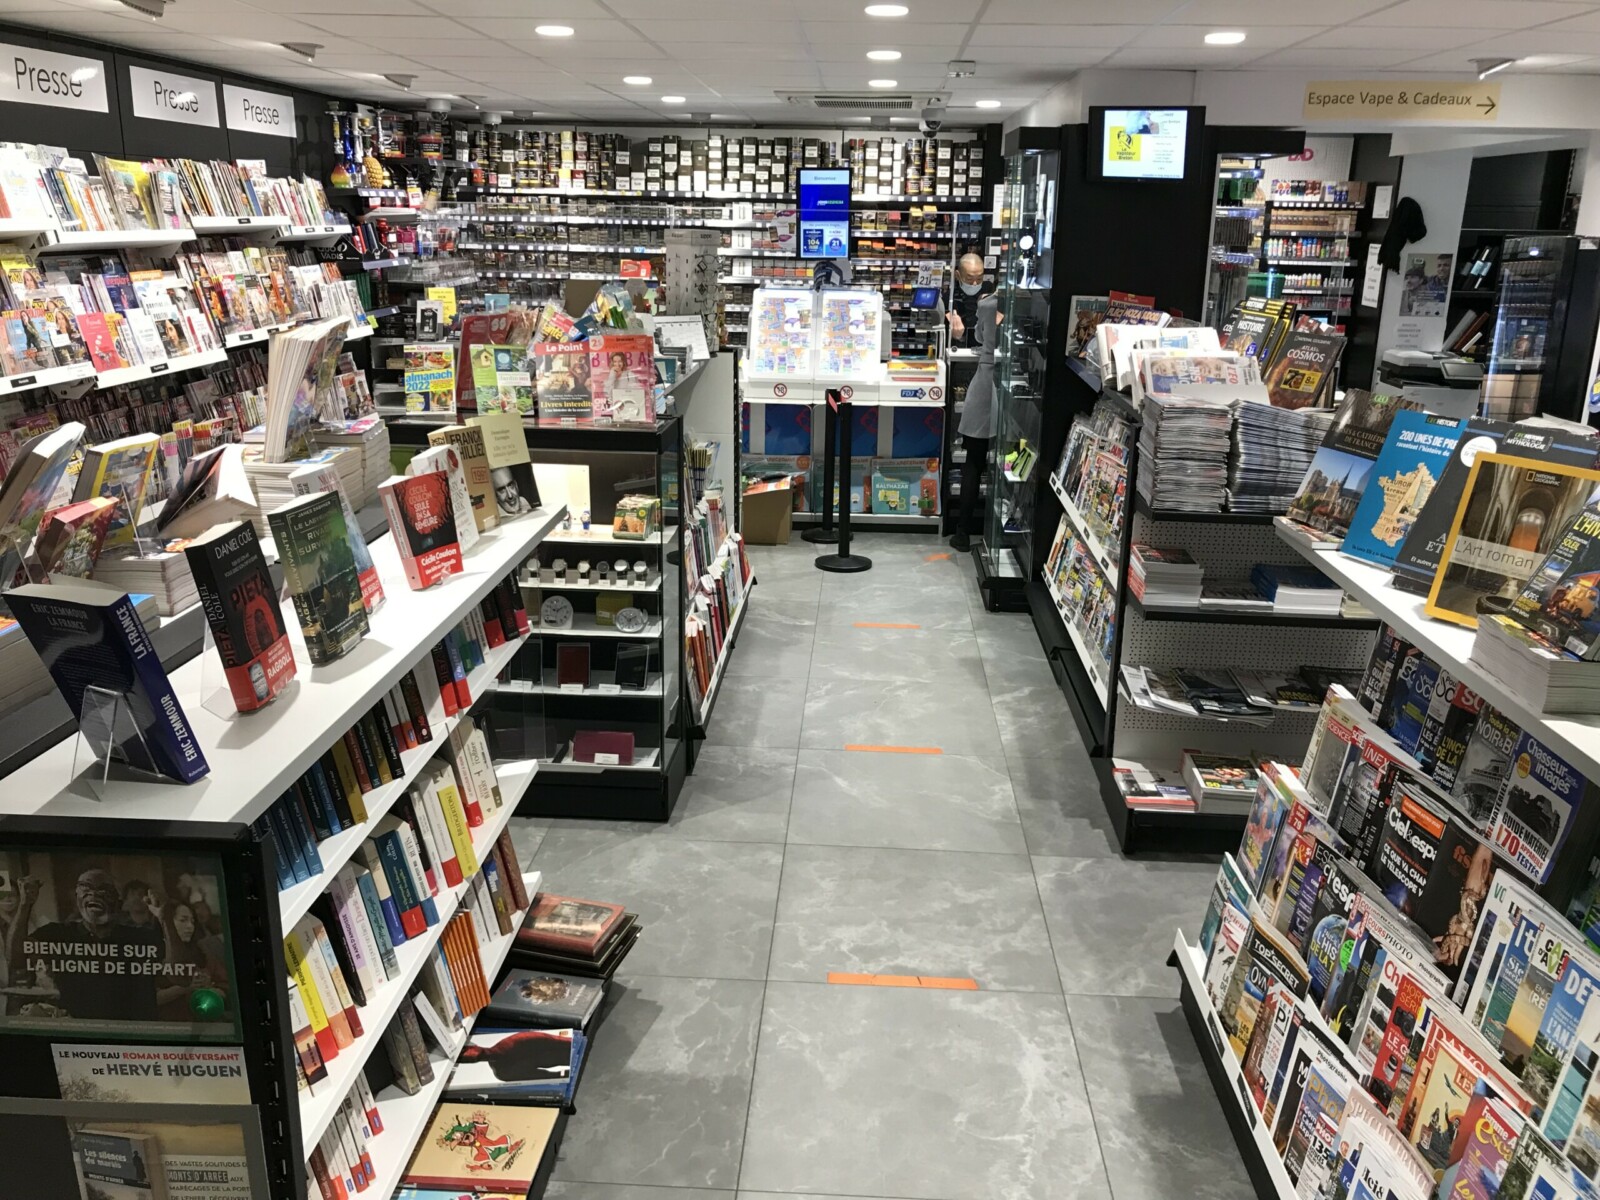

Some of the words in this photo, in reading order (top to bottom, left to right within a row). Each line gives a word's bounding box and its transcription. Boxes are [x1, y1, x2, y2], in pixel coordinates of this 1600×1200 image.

[14, 57, 83, 98] Presse
[154, 80, 199, 114] Presse
[1308, 92, 1355, 107] Espace
[1360, 92, 1394, 107] Vape
[1398, 93, 1408, 105] &
[1413, 92, 1472, 106] Cadeaux
[242, 98, 280, 126] Presse
[546, 344, 557, 352] Le
[558, 343, 584, 352] Point
[1287, 349, 1326, 363] COSMOS
[406, 370, 453, 384] almanach
[406, 381, 431, 392] 2022
[449, 430, 482, 446] FRANCK
[1399, 430, 1415, 442] 200
[1414, 432, 1433, 445] UNES
[1432, 436, 1444, 448] DE
[1506, 438, 1547, 450] MYTHOLOGIE
[214, 536, 239, 560] DANIEL
[238, 528, 253, 548] COLE
[1455, 541, 1484, 559] L'Art
[1486, 549, 1535, 570] roman
[199, 583, 217, 624] DANIEL
[213, 592, 225, 620] COLE
[115, 605, 140, 646] FRANCE
[135, 642, 148, 660] LA
[267, 652, 292, 680] RAGDOLL
[160, 693, 191, 747] ZEMMOUR
[1527, 737, 1569, 778] Chasseur
[1534, 762, 1571, 795] images
[1501, 811, 1525, 840] GUIDE
[1523, 829, 1550, 862] MATÉRIEL
[23, 941, 118, 958] BIENVENUE
[123, 944, 158, 958] SUR
[1317, 930, 1338, 961] L'HIS
[26, 958, 46, 971] LA
[51, 959, 99, 974] LIGNE
[105, 961, 125, 975] DE
[131, 960, 199, 977] DÉPART.
[1254, 938, 1272, 958] TOP
[1271, 955, 1300, 989] SECRET
[1384, 959, 1401, 989] Ch
[59, 1051, 70, 1059] LE
[72, 1051, 120, 1060] NOUVEAU
[123, 1052, 161, 1061] ROMAN
[163, 1053, 240, 1061] BOULEVERSANT
[92, 1067, 105, 1075] DE
[107, 1061, 163, 1077] HERVÉ
[168, 1064, 242, 1077] HUGUEN
[1481, 1105, 1509, 1141] Femme
[84, 1149, 98, 1157] Les
[1311, 1133, 1331, 1161] 135
[167, 1170, 194, 1182] MONTS
